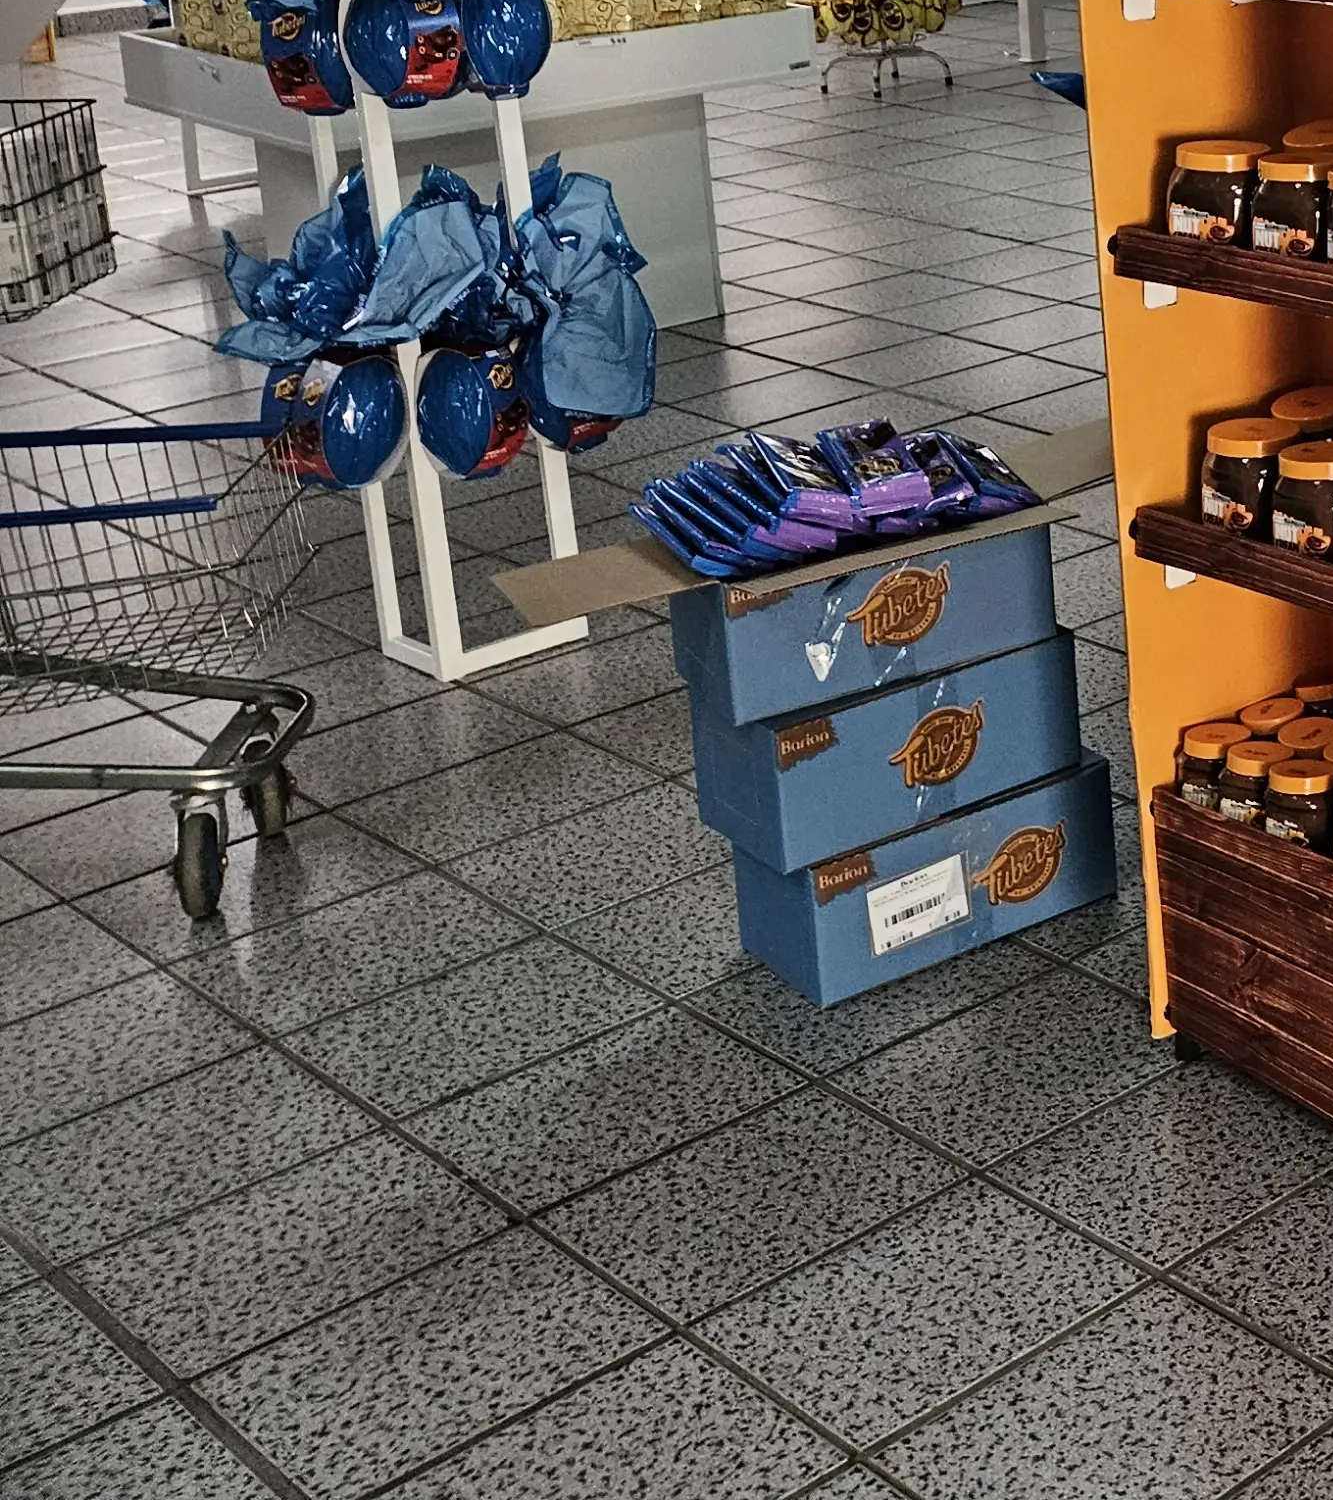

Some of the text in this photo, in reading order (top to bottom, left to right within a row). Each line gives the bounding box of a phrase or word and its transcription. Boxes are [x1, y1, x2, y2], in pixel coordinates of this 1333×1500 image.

[844, 559, 950, 647] Tubetes
[781, 730, 830, 755] Barion
[888, 697, 985, 788] Tubetes
[818, 863, 868, 889] Barion
[970, 819, 1068, 906] Tubetes
